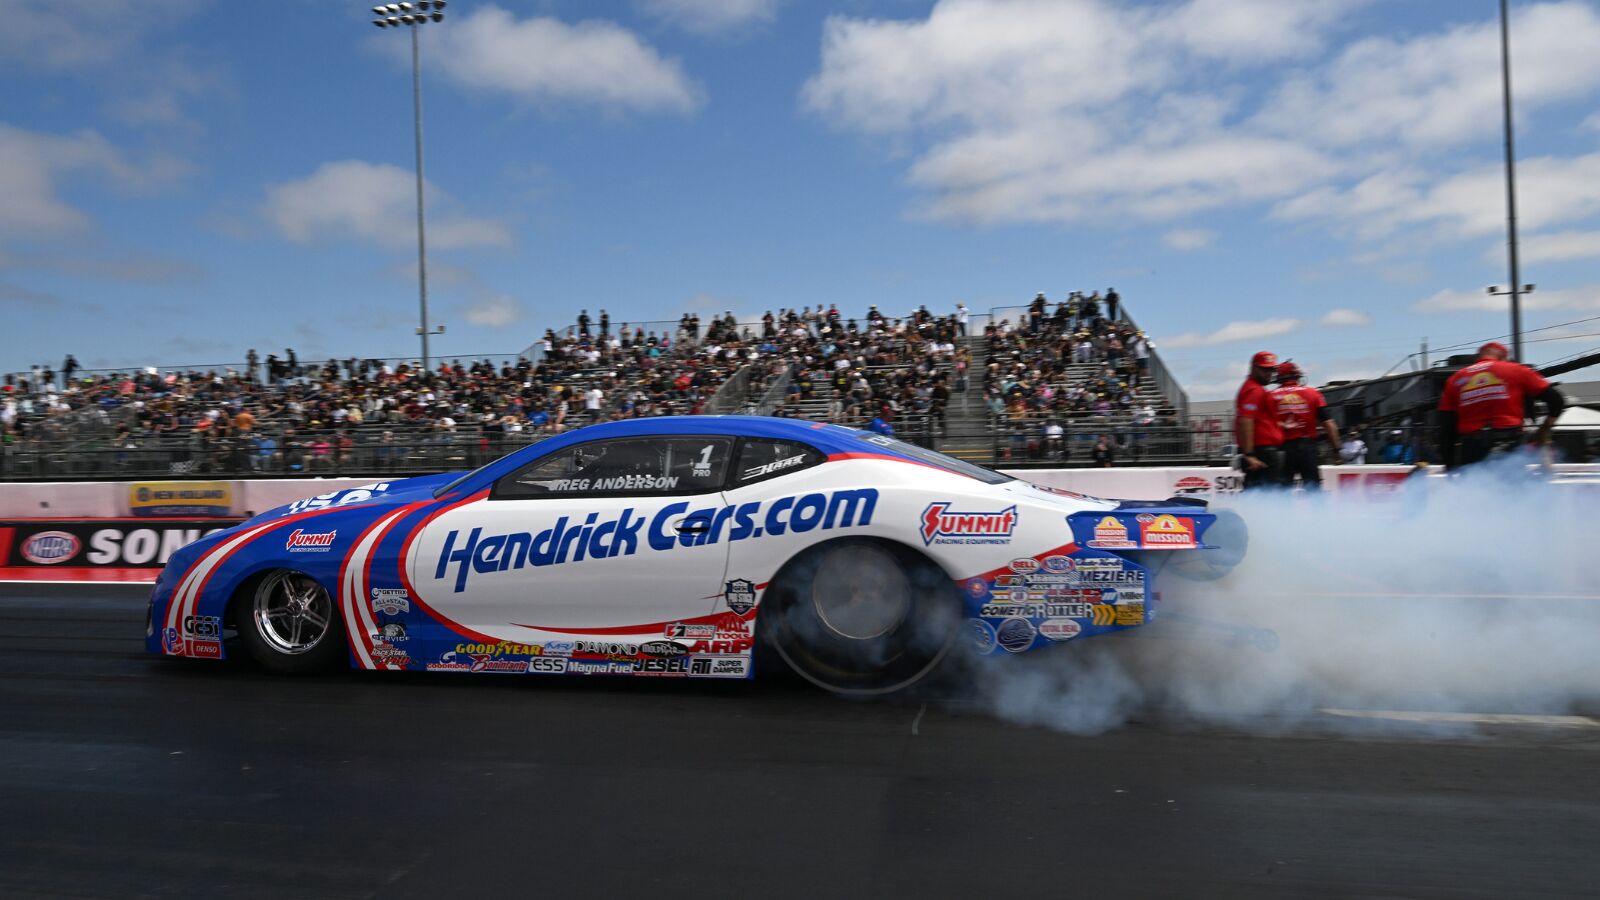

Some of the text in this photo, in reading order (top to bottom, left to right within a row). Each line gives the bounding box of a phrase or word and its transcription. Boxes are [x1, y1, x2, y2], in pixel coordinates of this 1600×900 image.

[694, 445, 714, 469] 1
[692, 469, 711, 477] PRO
[548, 476, 679, 491] GREG ANDERSON
[921, 503, 1015, 541] SUMMIT
[287, 529, 336, 548] SUMMIT
[86, 528, 226, 564] SON
[1080, 571, 1145, 581] MEZIERE
[981, 606, 1036, 616] COMETIC
[1036, 603, 1094, 618] ROTTLER
[196, 645, 218, 653] DENSO
[575, 641, 638, 655] DIAMOND
[689, 640, 752, 653] ARP
[533, 659, 563, 671] ESS
[567, 662, 633, 674] MagnaFuel
[632, 658, 688, 672] JESEL
[691, 659, 712, 674] ATI
